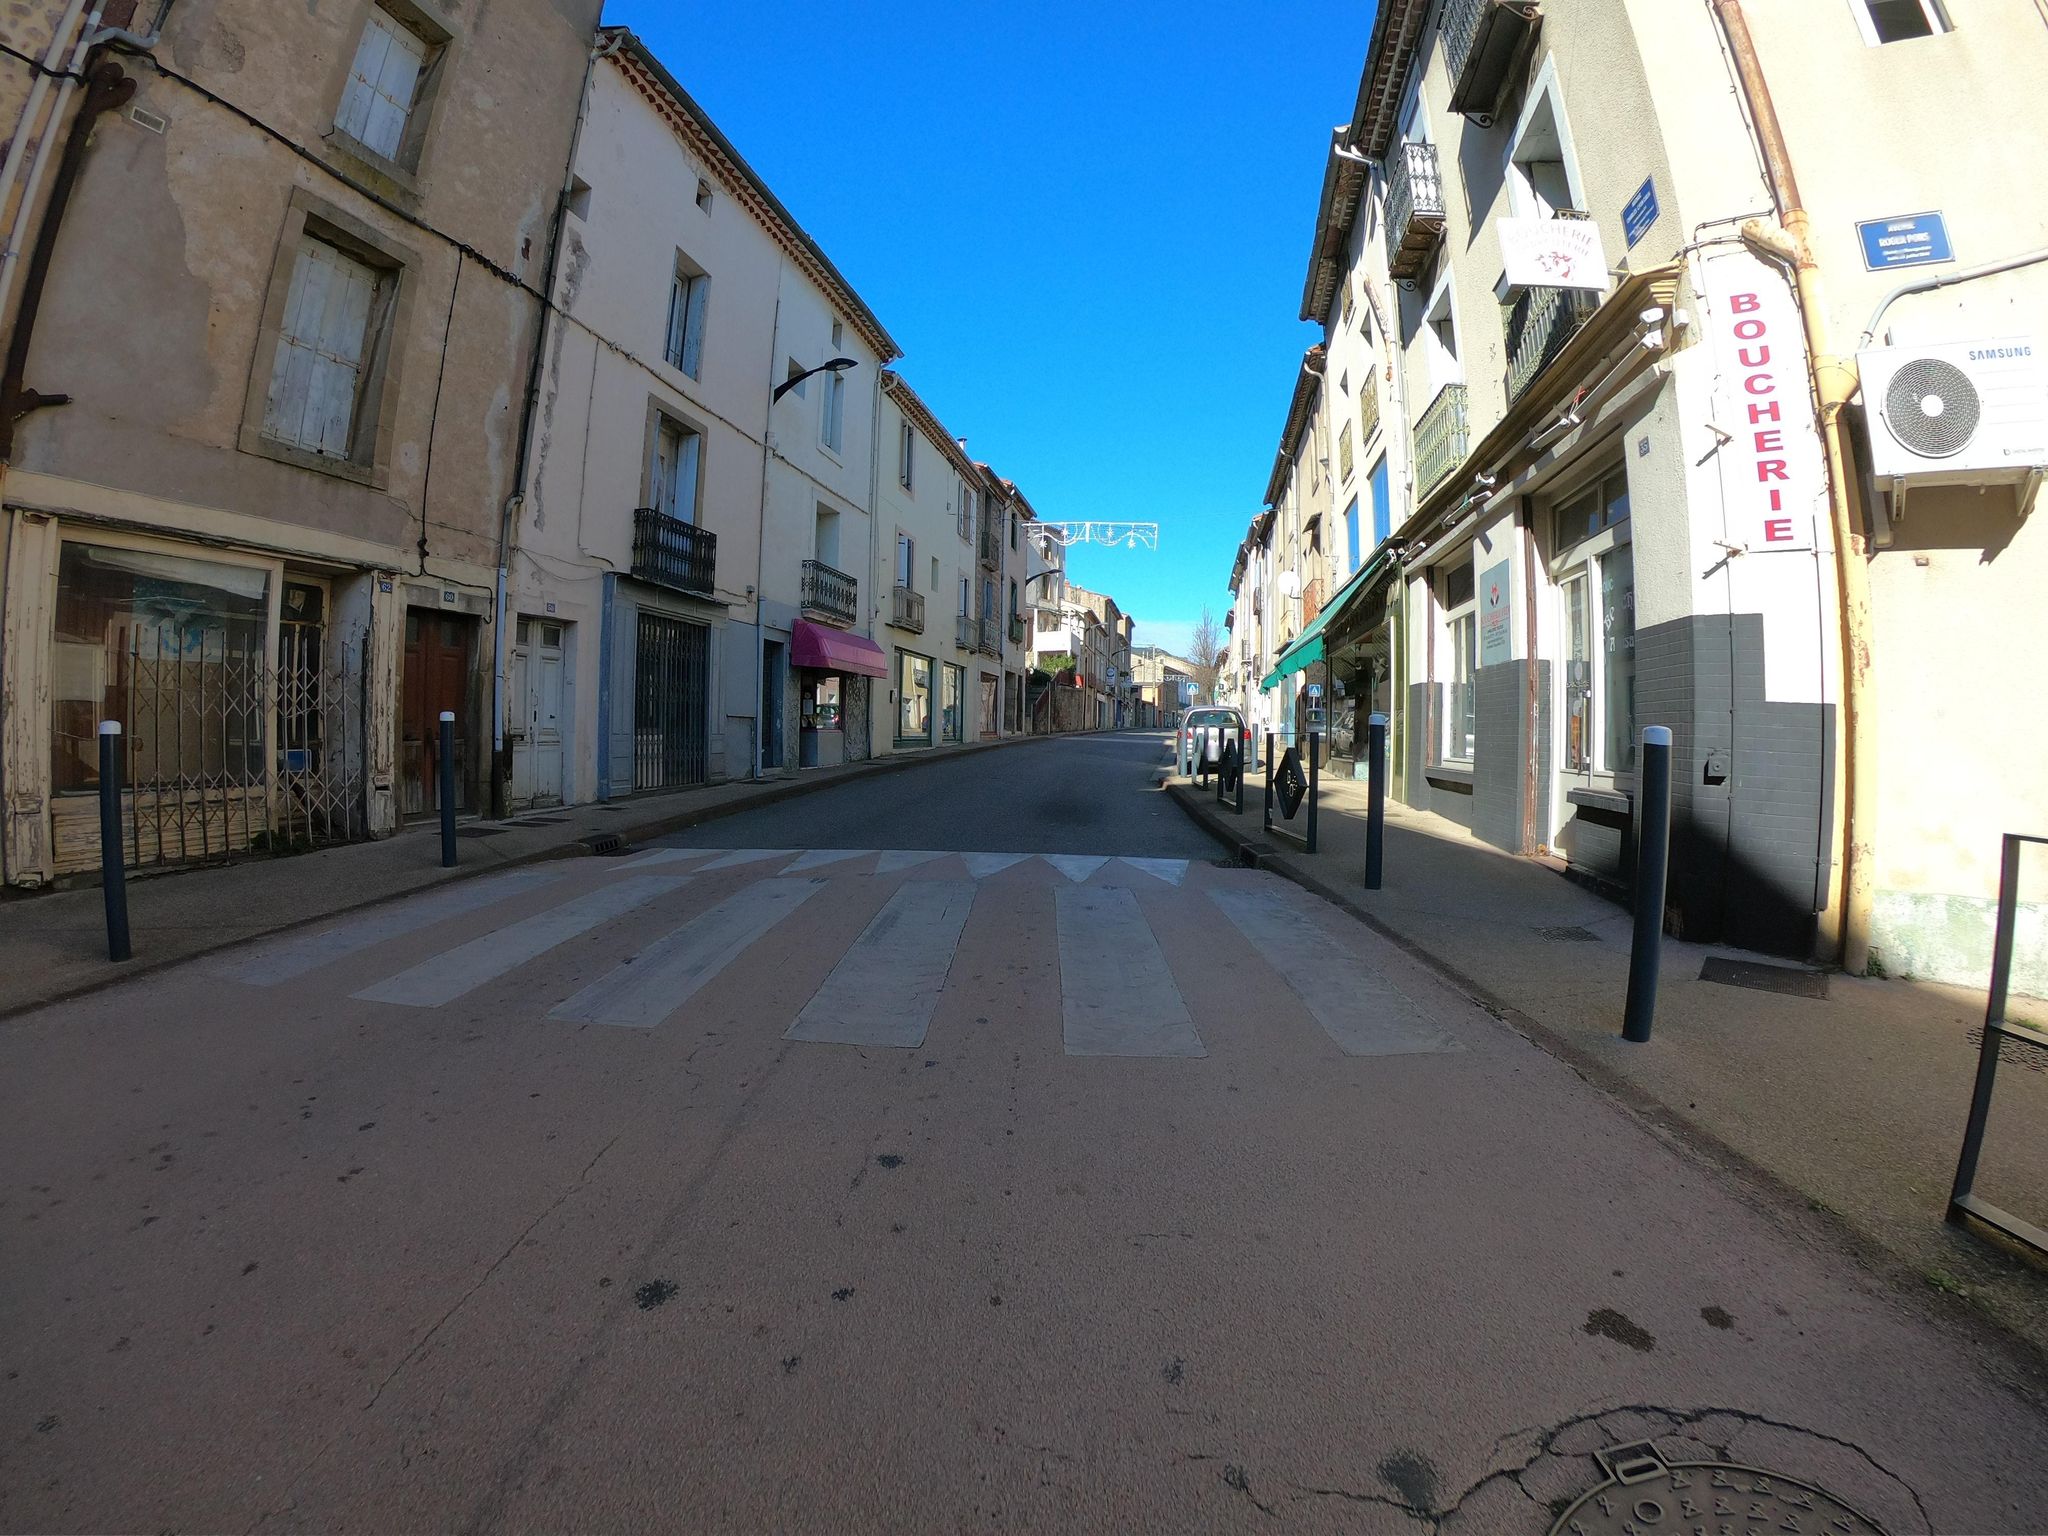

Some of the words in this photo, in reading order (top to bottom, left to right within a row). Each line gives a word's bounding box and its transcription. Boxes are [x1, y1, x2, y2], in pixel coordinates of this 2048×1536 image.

[1968, 346, 2032, 361] SAMSUNG
[1729, 293, 1794, 542] BOUCHERIE
[382, 583, 391, 592] 62
[445, 592, 454, 601] 60
